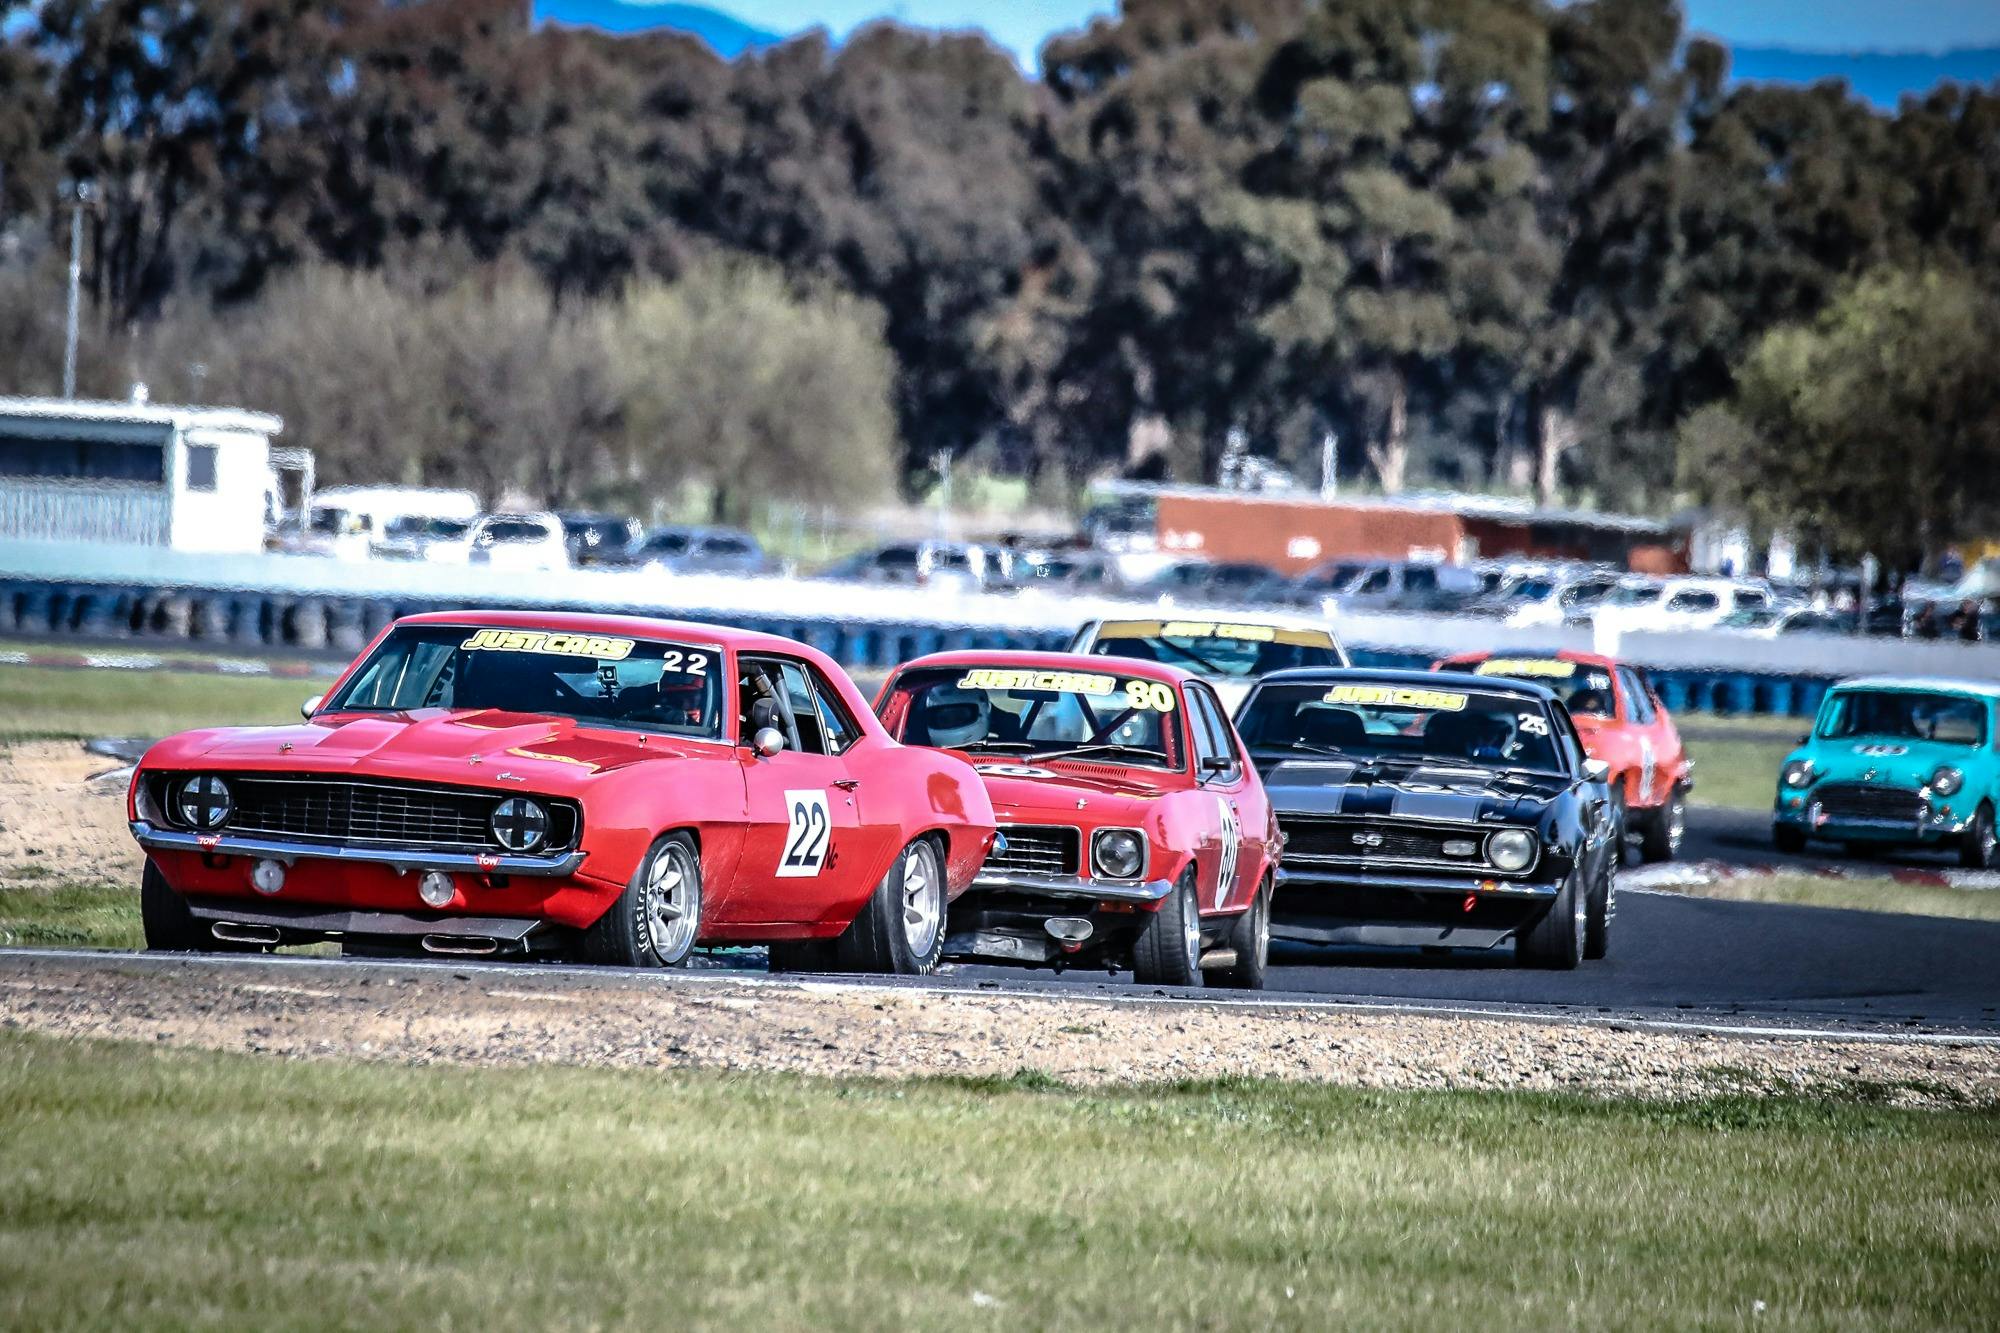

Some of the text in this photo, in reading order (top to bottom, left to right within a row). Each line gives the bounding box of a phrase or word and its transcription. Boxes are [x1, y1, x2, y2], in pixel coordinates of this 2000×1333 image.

[463, 630, 634, 659] JUST CARS
[662, 651, 708, 676] 22
[959, 671, 1114, 694] JUST CARS
[1125, 680, 1175, 712] 80
[1518, 713, 1548, 736] 25
[199, 837, 217, 845] TOW
[785, 802, 826, 866] 22
[1352, 833, 1382, 846] SS
[479, 857, 499, 865] TOW
